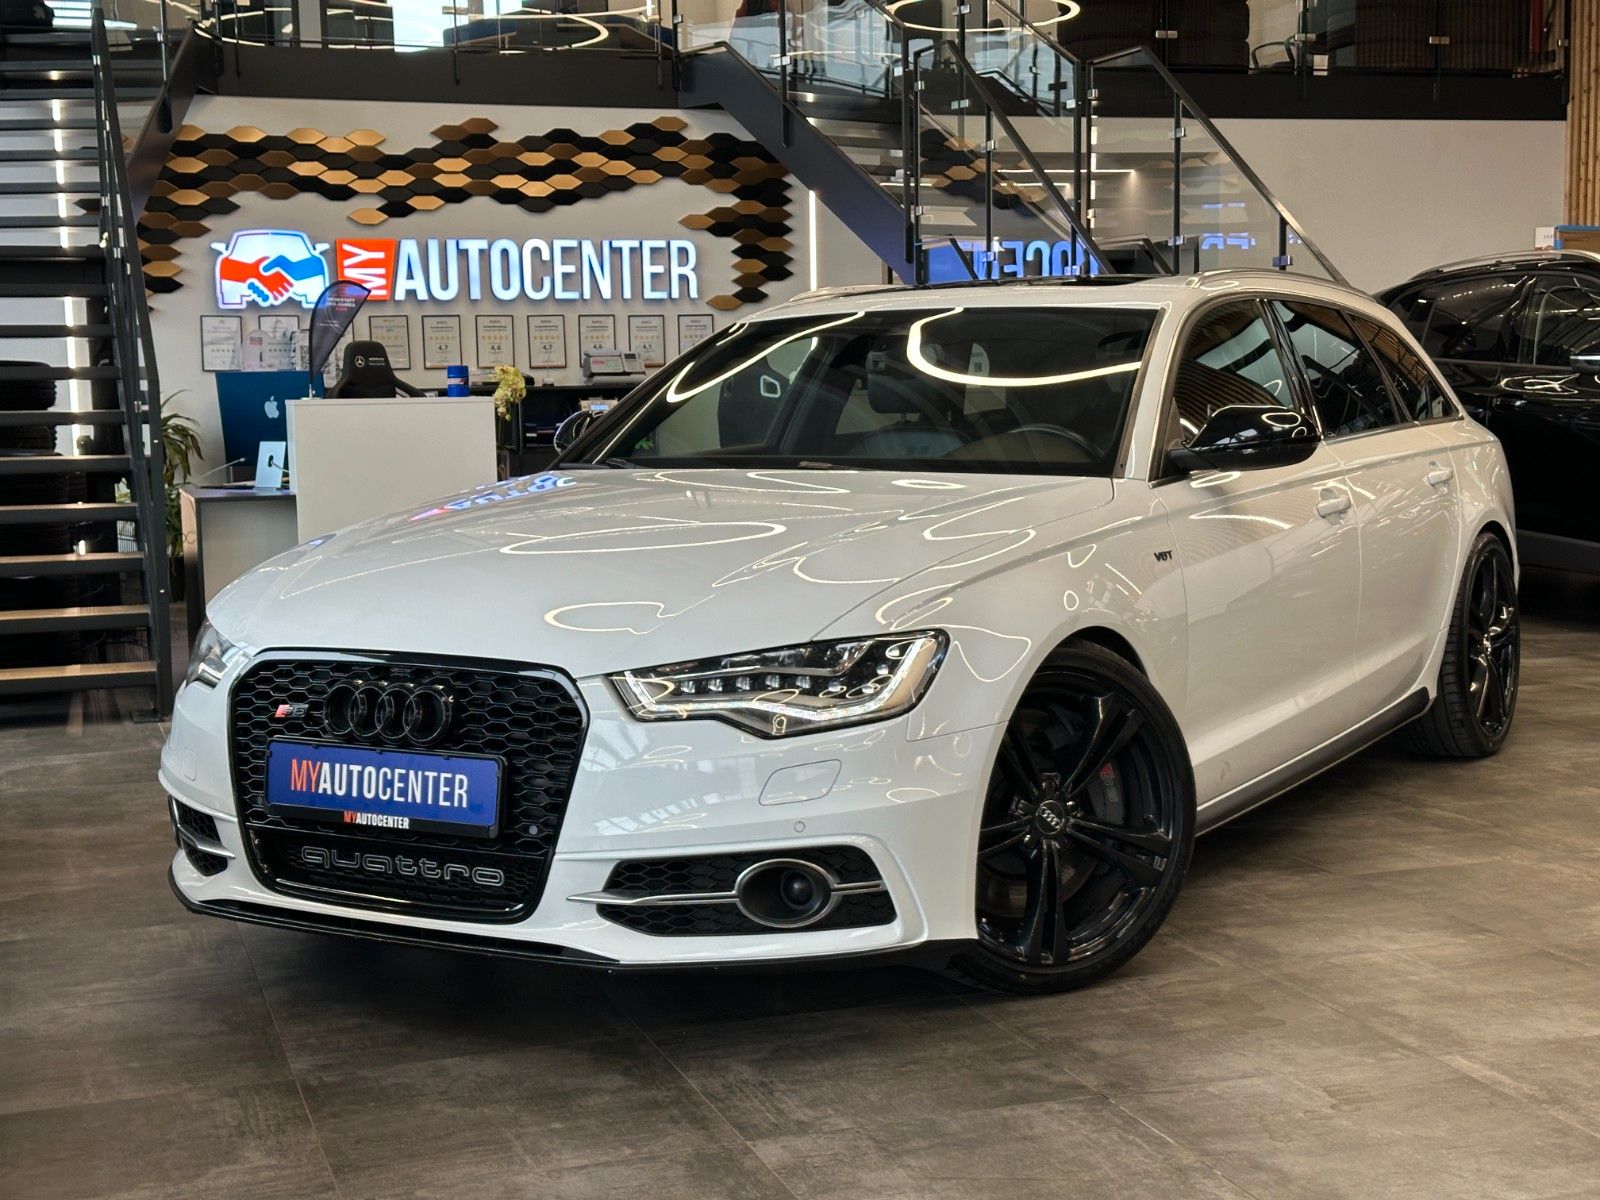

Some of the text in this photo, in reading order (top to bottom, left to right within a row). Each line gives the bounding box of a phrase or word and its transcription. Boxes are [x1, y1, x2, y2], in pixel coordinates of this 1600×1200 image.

[342, 239, 698, 300] MY AUTOCENTER
[291, 758, 468, 808] MYAUTOCENTER
[343, 810, 410, 830] MYAUTOCENTER
[301, 845, 504, 886] quattro
